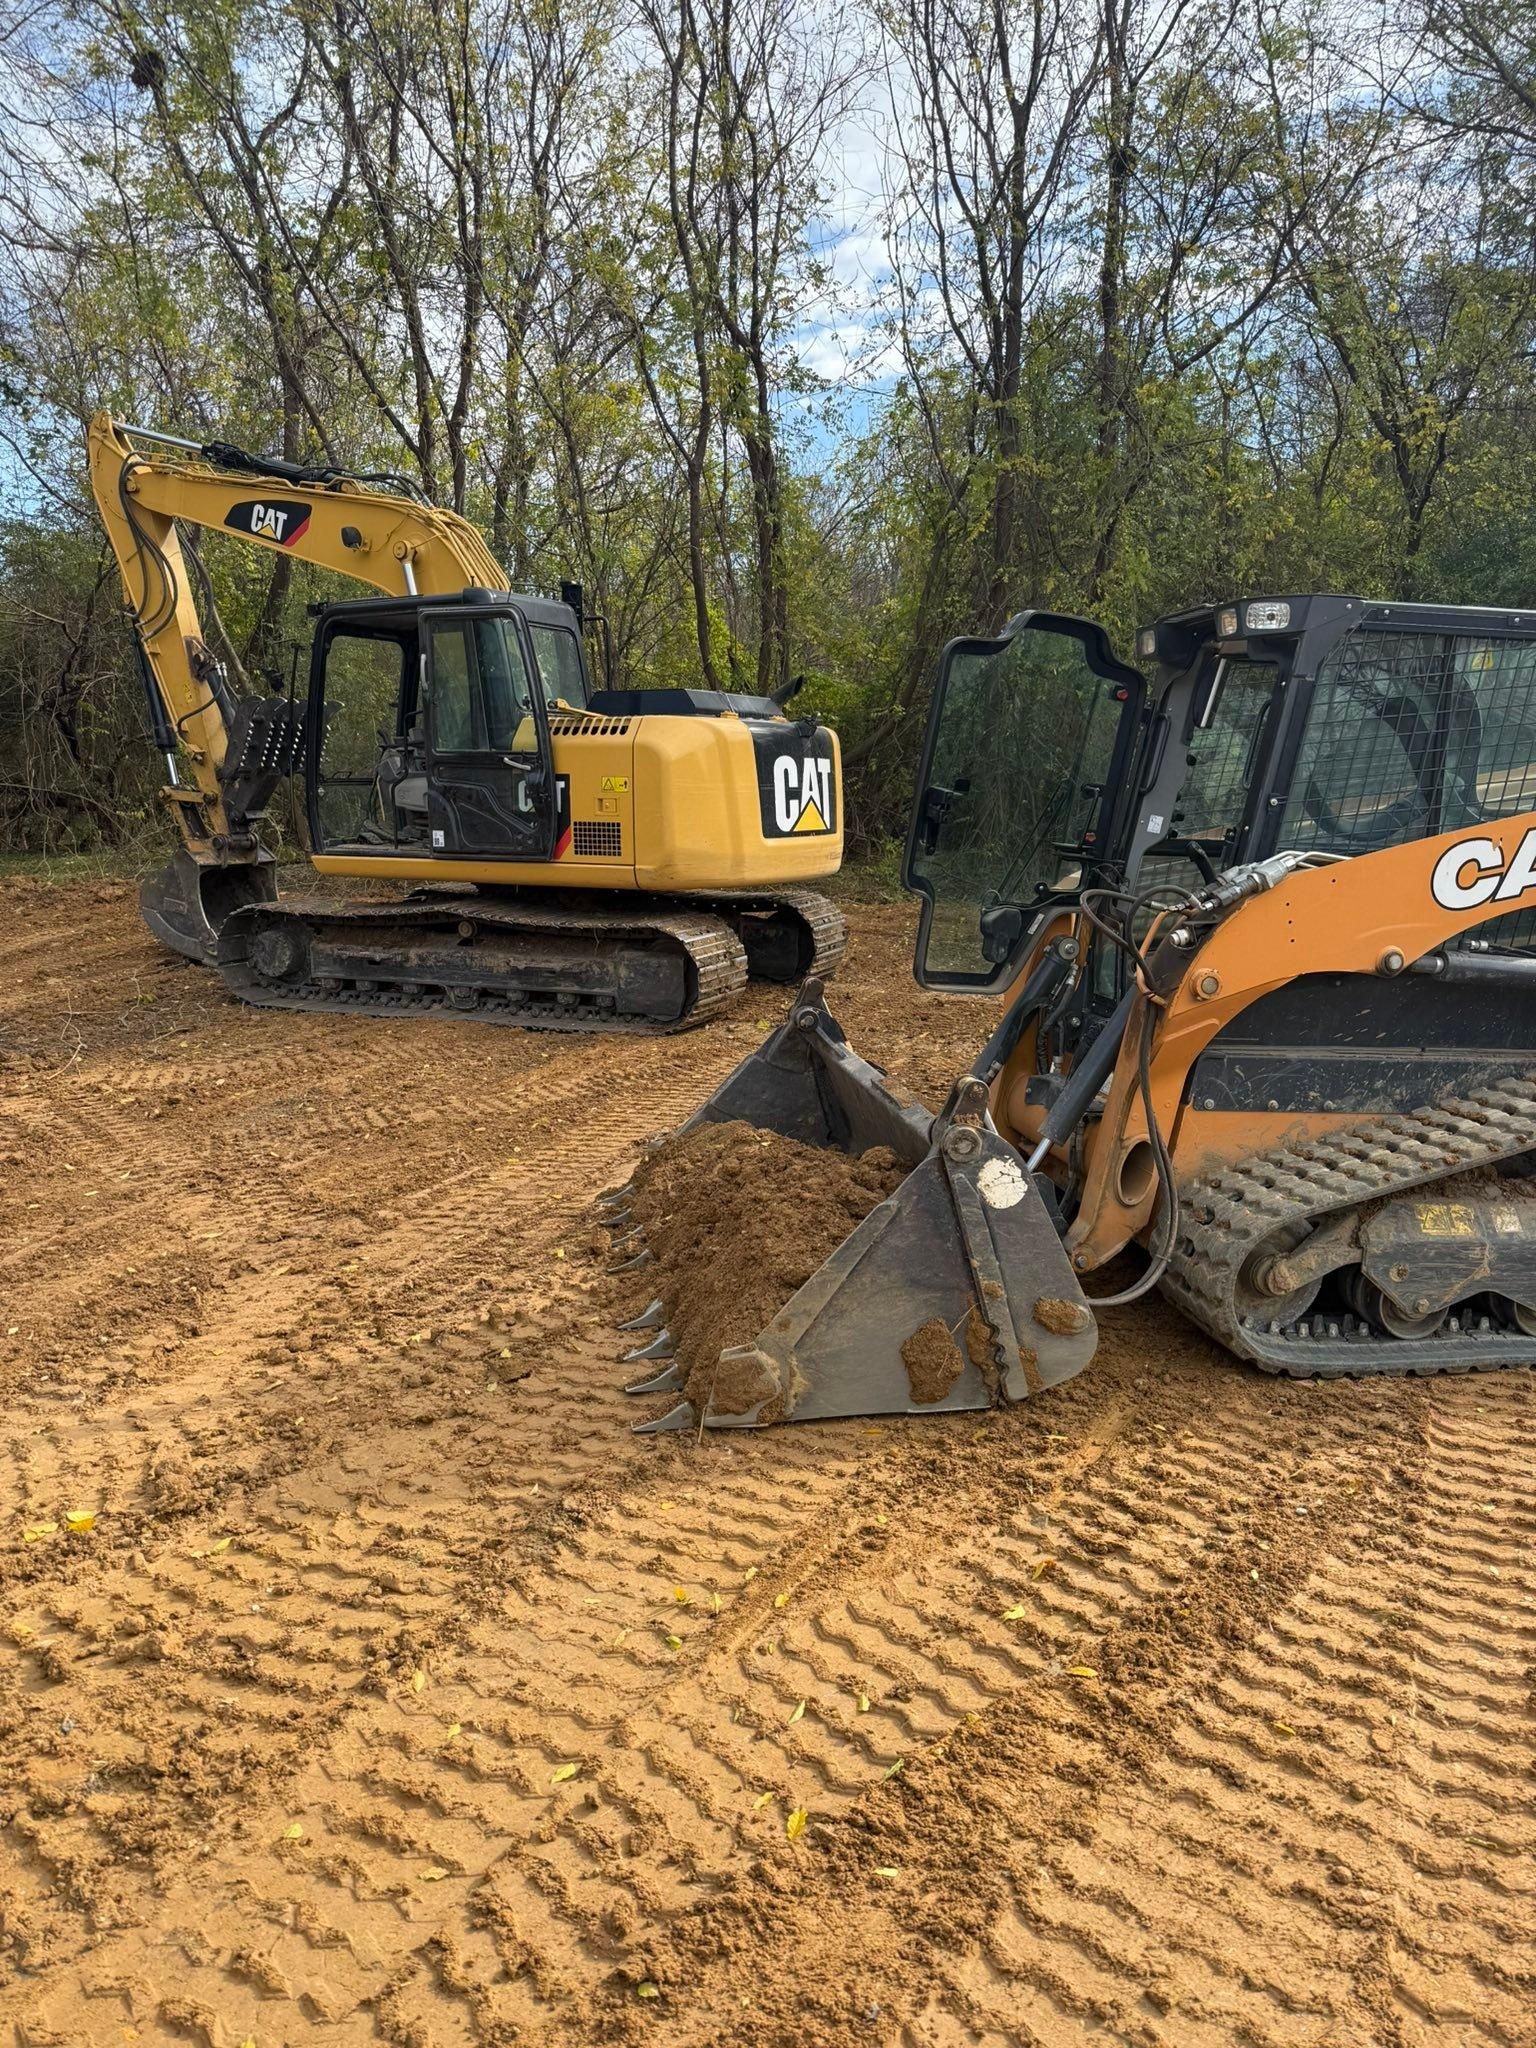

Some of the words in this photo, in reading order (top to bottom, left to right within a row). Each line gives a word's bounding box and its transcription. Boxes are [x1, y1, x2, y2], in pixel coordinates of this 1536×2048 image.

[250, 503, 288, 541] CAT
[518, 780, 566, 813] CT
[773, 755, 831, 833] CAT
